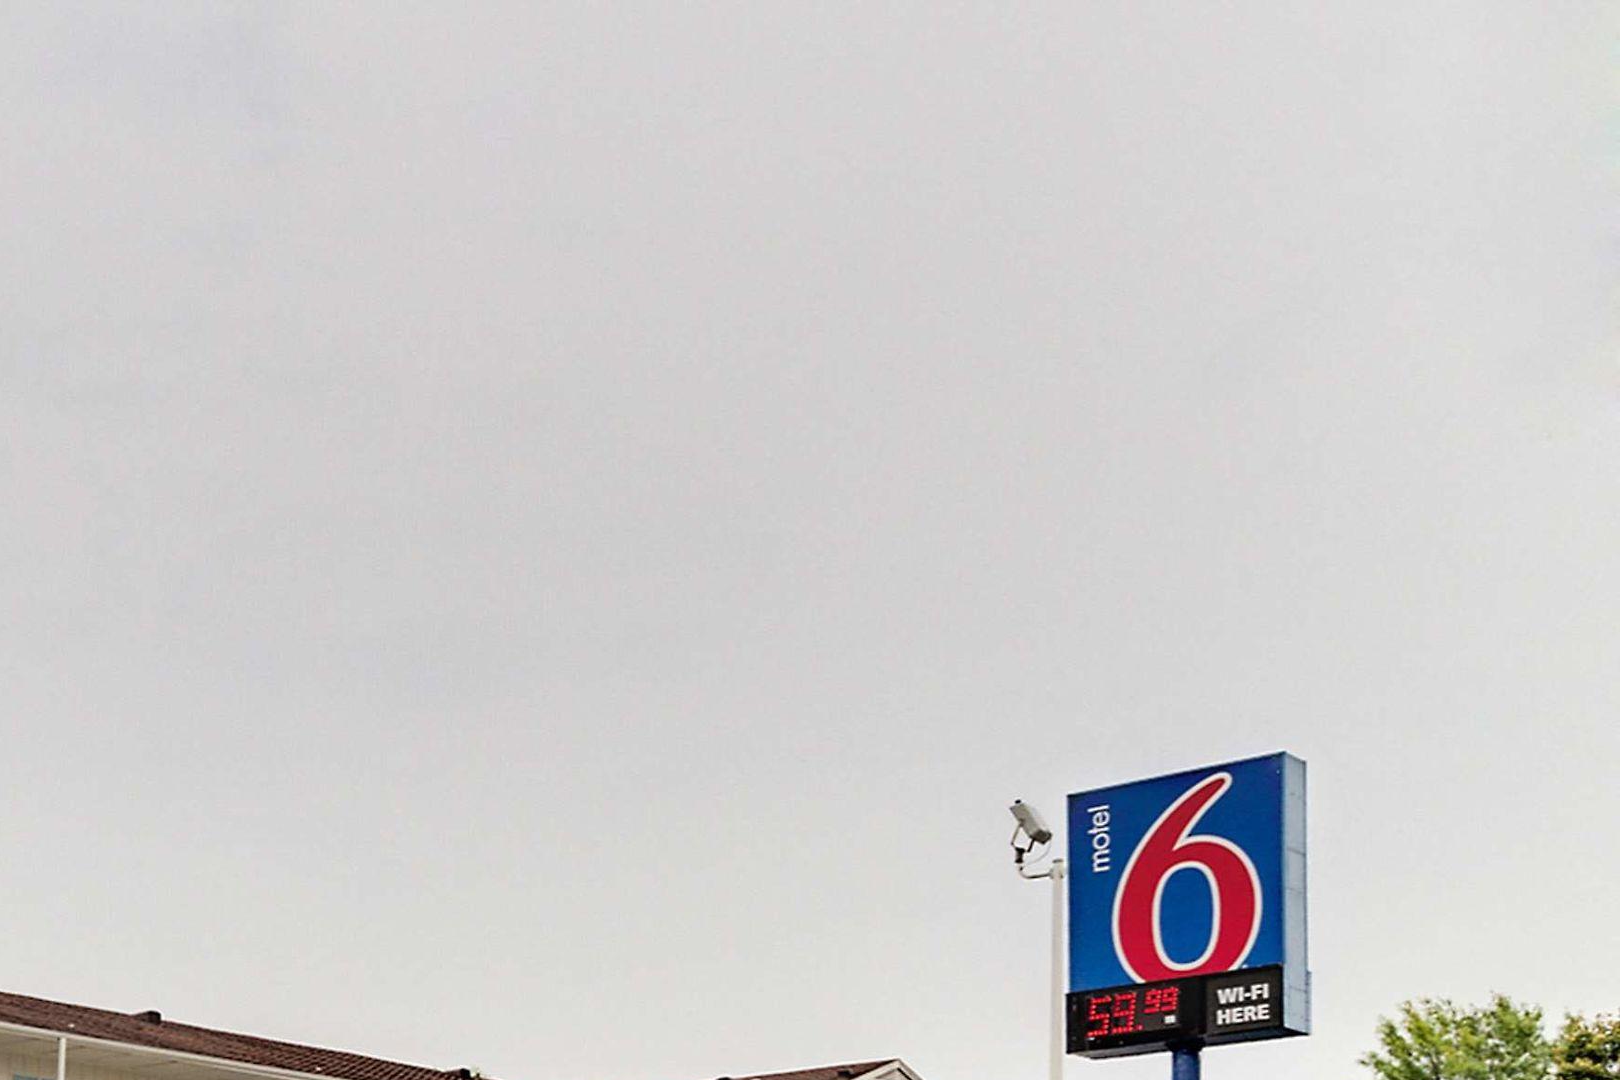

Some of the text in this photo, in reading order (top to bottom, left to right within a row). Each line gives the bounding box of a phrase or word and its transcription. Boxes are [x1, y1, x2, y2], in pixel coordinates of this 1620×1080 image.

[1087, 804, 1111, 873] motel
[1111, 772, 1263, 984] 6
[1215, 983, 1270, 1005] WI-FI
[1215, 1003, 1271, 1026] HERE
